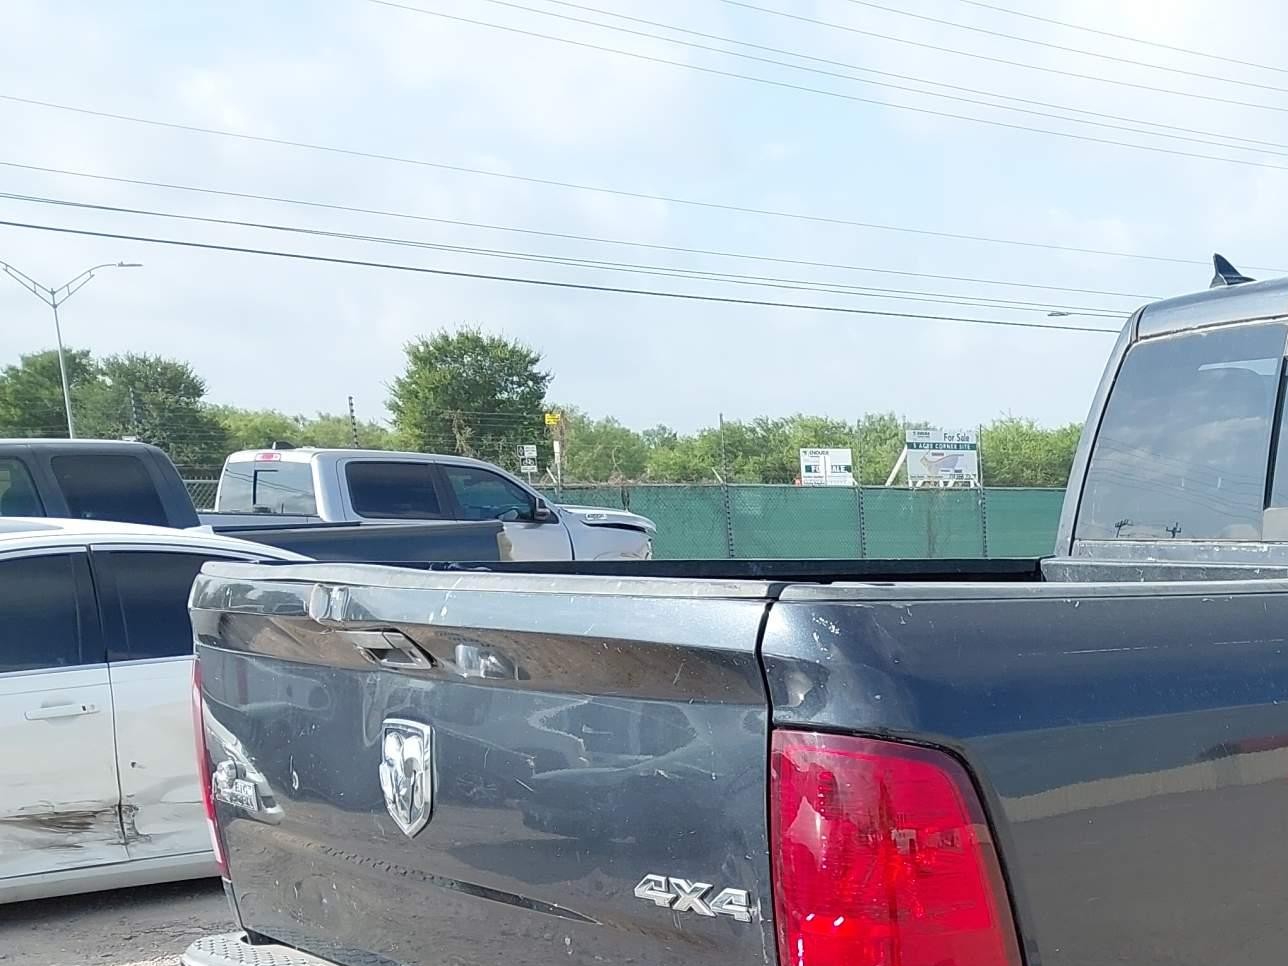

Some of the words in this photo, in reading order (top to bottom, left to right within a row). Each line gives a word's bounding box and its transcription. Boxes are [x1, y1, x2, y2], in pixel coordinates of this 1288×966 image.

[943, 433, 954, 442] For
[957, 433, 970, 442] Sale
[634, 873, 752, 923] 4X4
